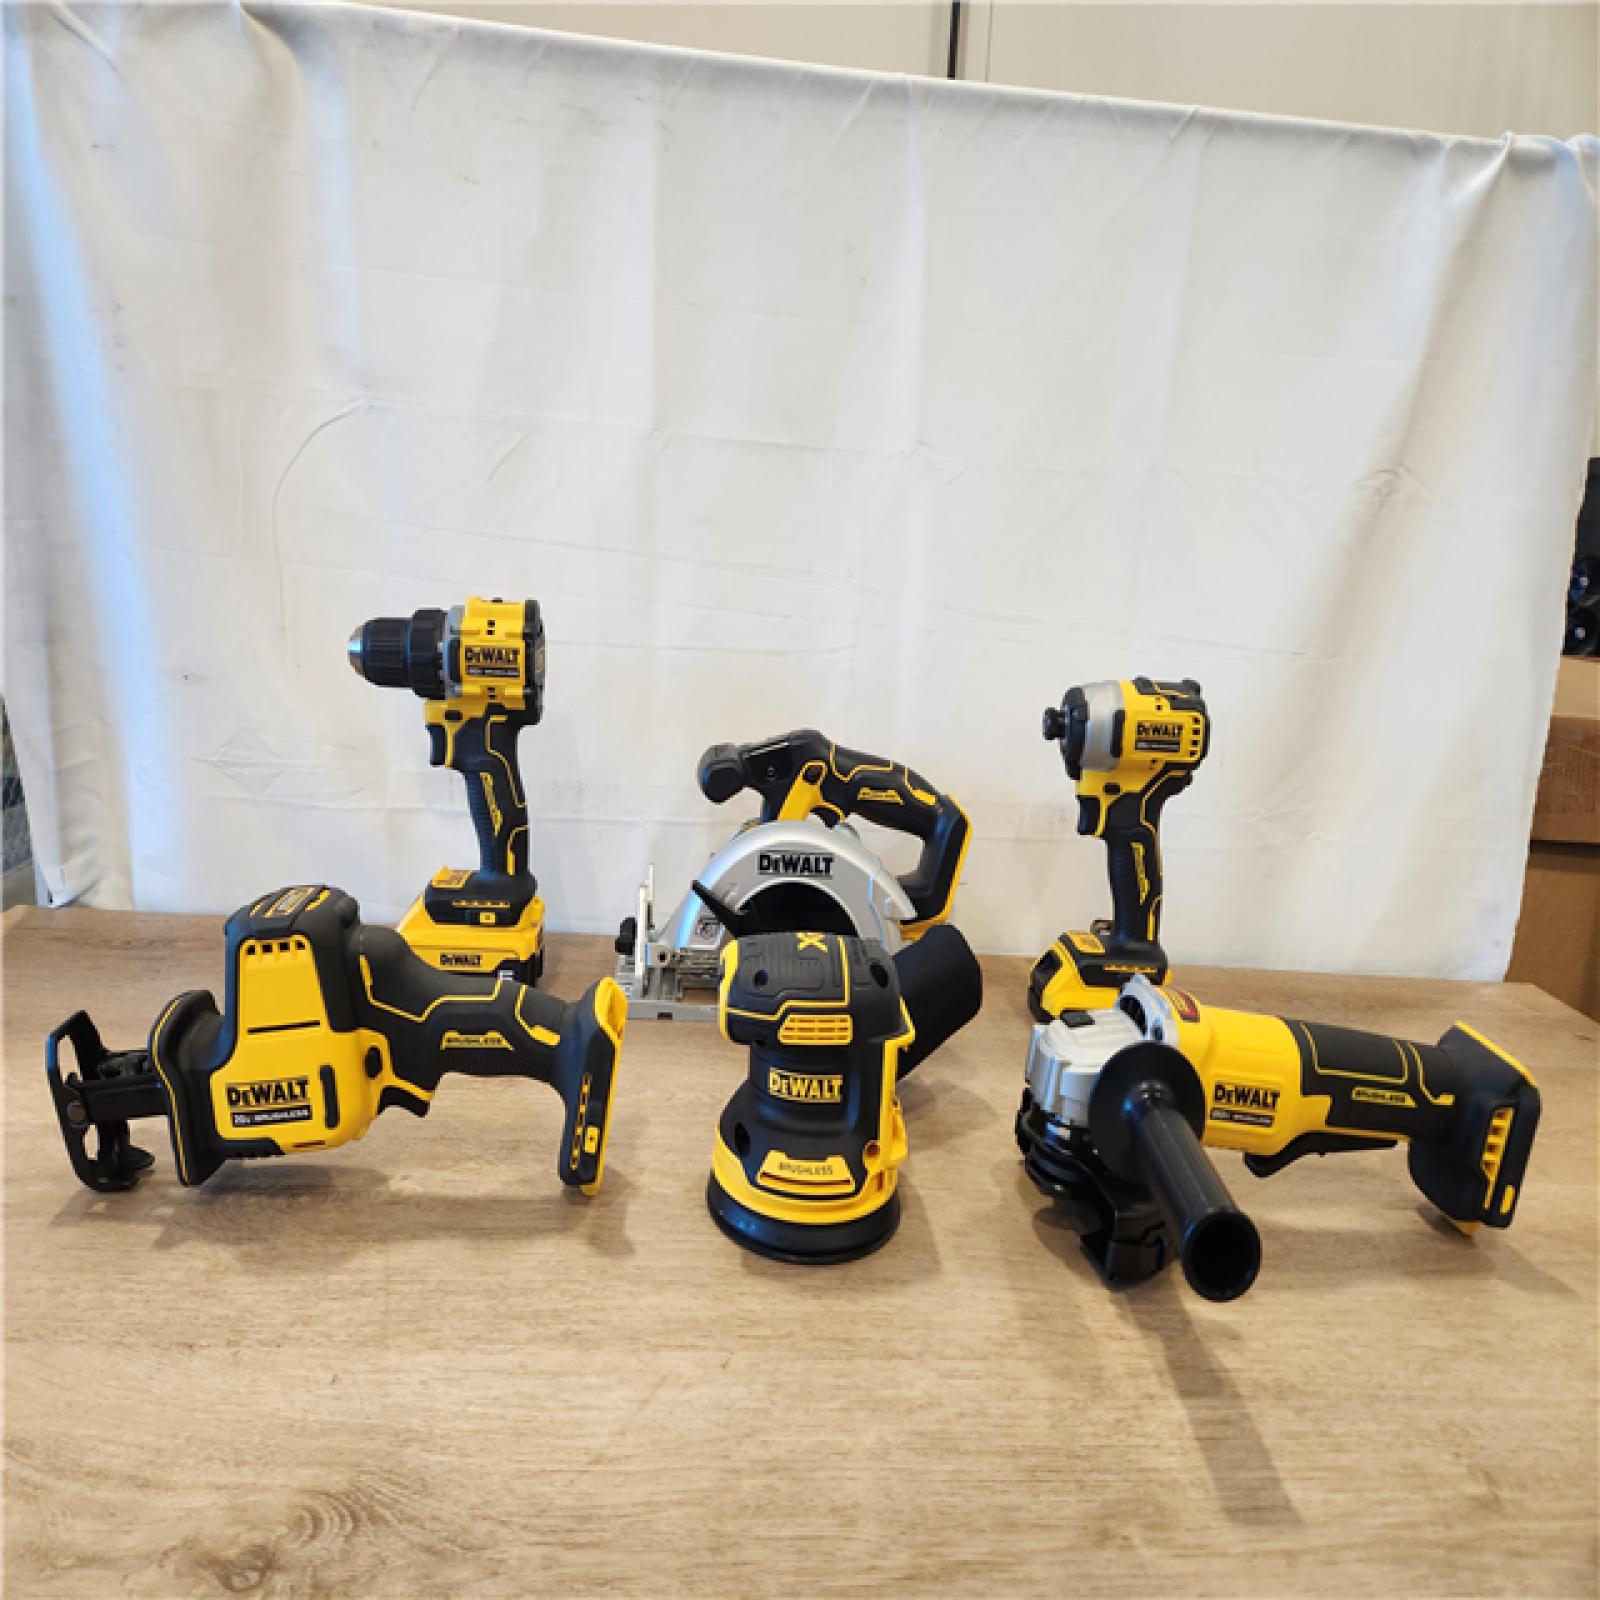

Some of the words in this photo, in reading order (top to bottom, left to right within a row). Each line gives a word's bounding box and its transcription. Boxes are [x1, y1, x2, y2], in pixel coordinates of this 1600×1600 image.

[759, 854, 833, 875] DEWALT
[226, 1079, 309, 1106] DEWALT
[769, 1070, 843, 1100] DEWALT
[1214, 1083, 1281, 1109] DEWALT
[778, 1161, 833, 1176] BRUSHLESS
